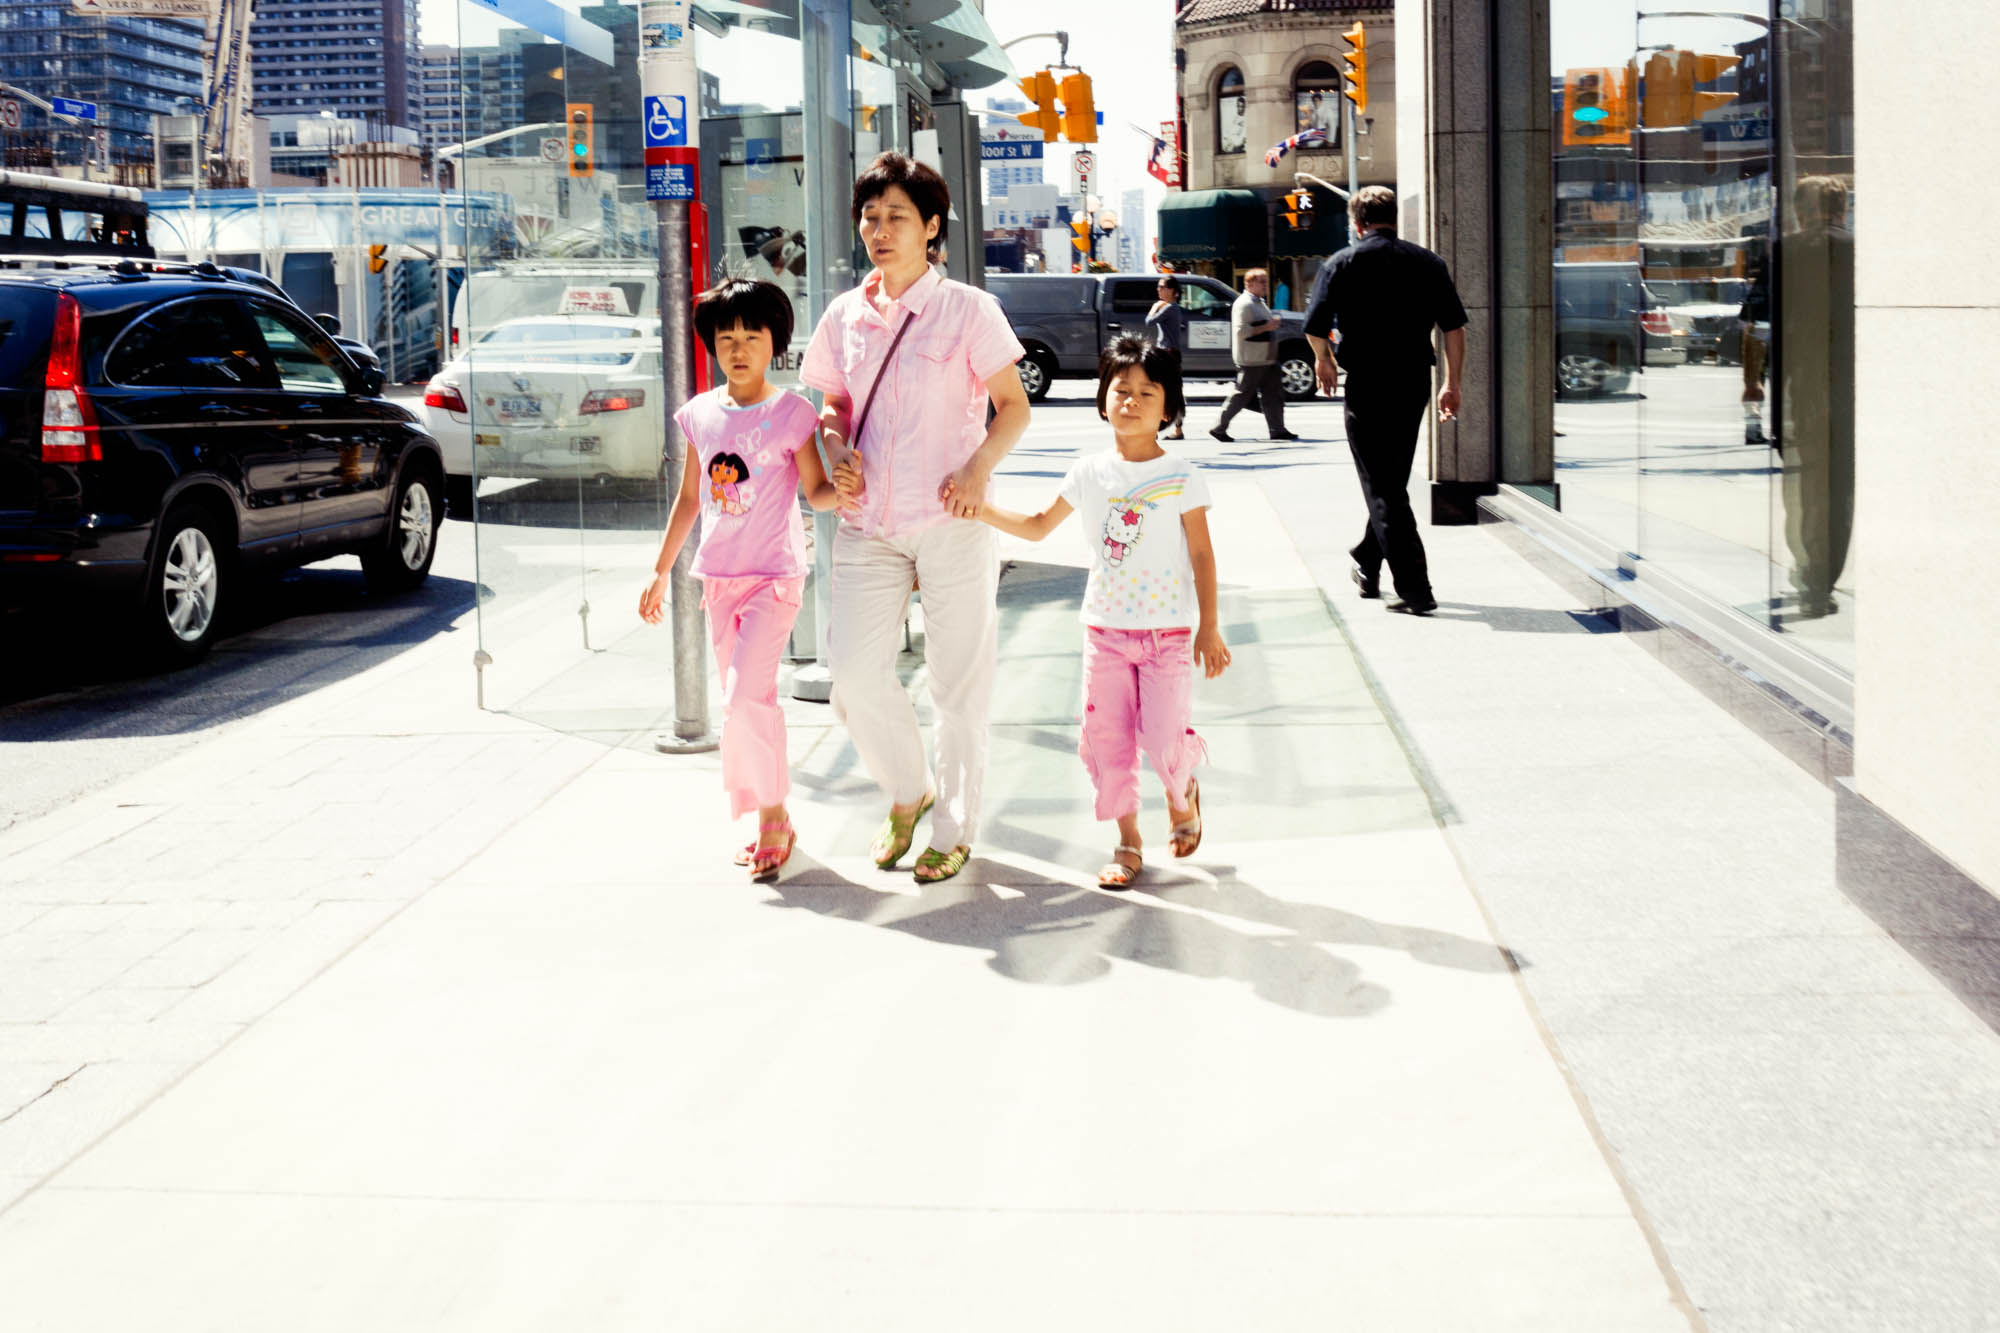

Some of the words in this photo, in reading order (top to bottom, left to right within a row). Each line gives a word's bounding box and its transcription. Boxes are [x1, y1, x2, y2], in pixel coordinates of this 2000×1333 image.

[981, 144, 1005, 157] loor
[1007, 146, 1017, 157] St
[1021, 143, 1032, 156] W
[360, 205, 440, 226] GREAT
[453, 210, 496, 229] GULF
